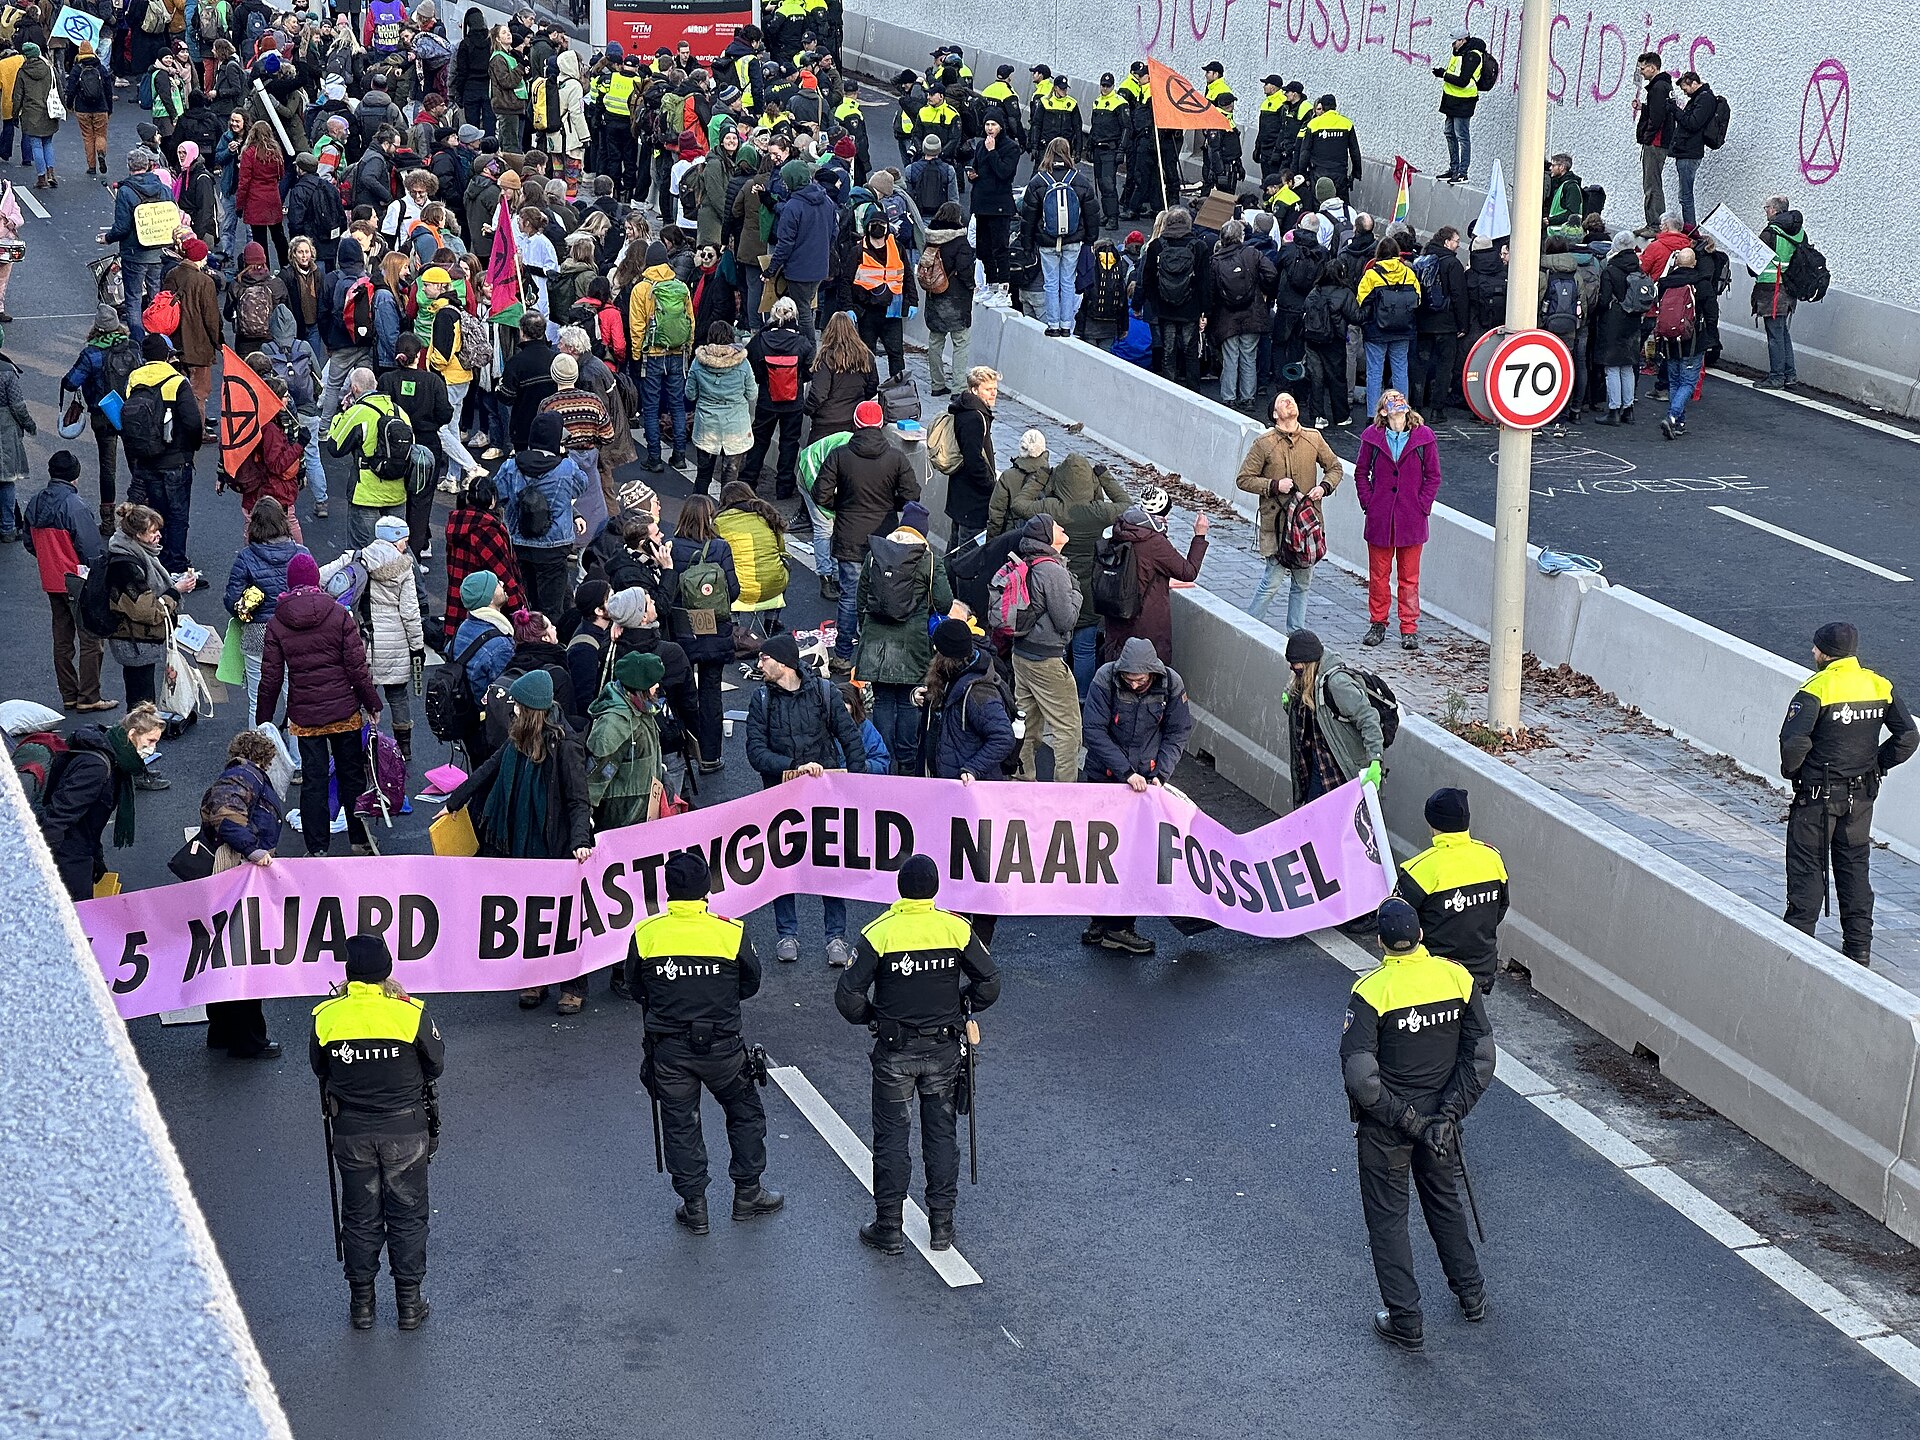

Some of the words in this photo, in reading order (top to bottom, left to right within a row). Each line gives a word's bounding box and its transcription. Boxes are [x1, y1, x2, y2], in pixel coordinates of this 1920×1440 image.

[632, 24, 653, 33] HTM
[1506, 362, 1557, 398] 70
[1833, 703, 1884, 724] POLITIE
[183, 895, 440, 983] MILJARD
[479, 806, 915, 960] BELASTNGGELD
[949, 816, 1119, 885] NAAR
[1157, 821, 1341, 914] FOSSIEL
[1445, 888, 1499, 912] POLITIE
[656, 956, 720, 980] POLITIE
[892, 952, 955, 976] POLITIE
[1398, 1006, 1460, 1033] POLITIE
[332, 1040, 399, 1064] POLITIE
